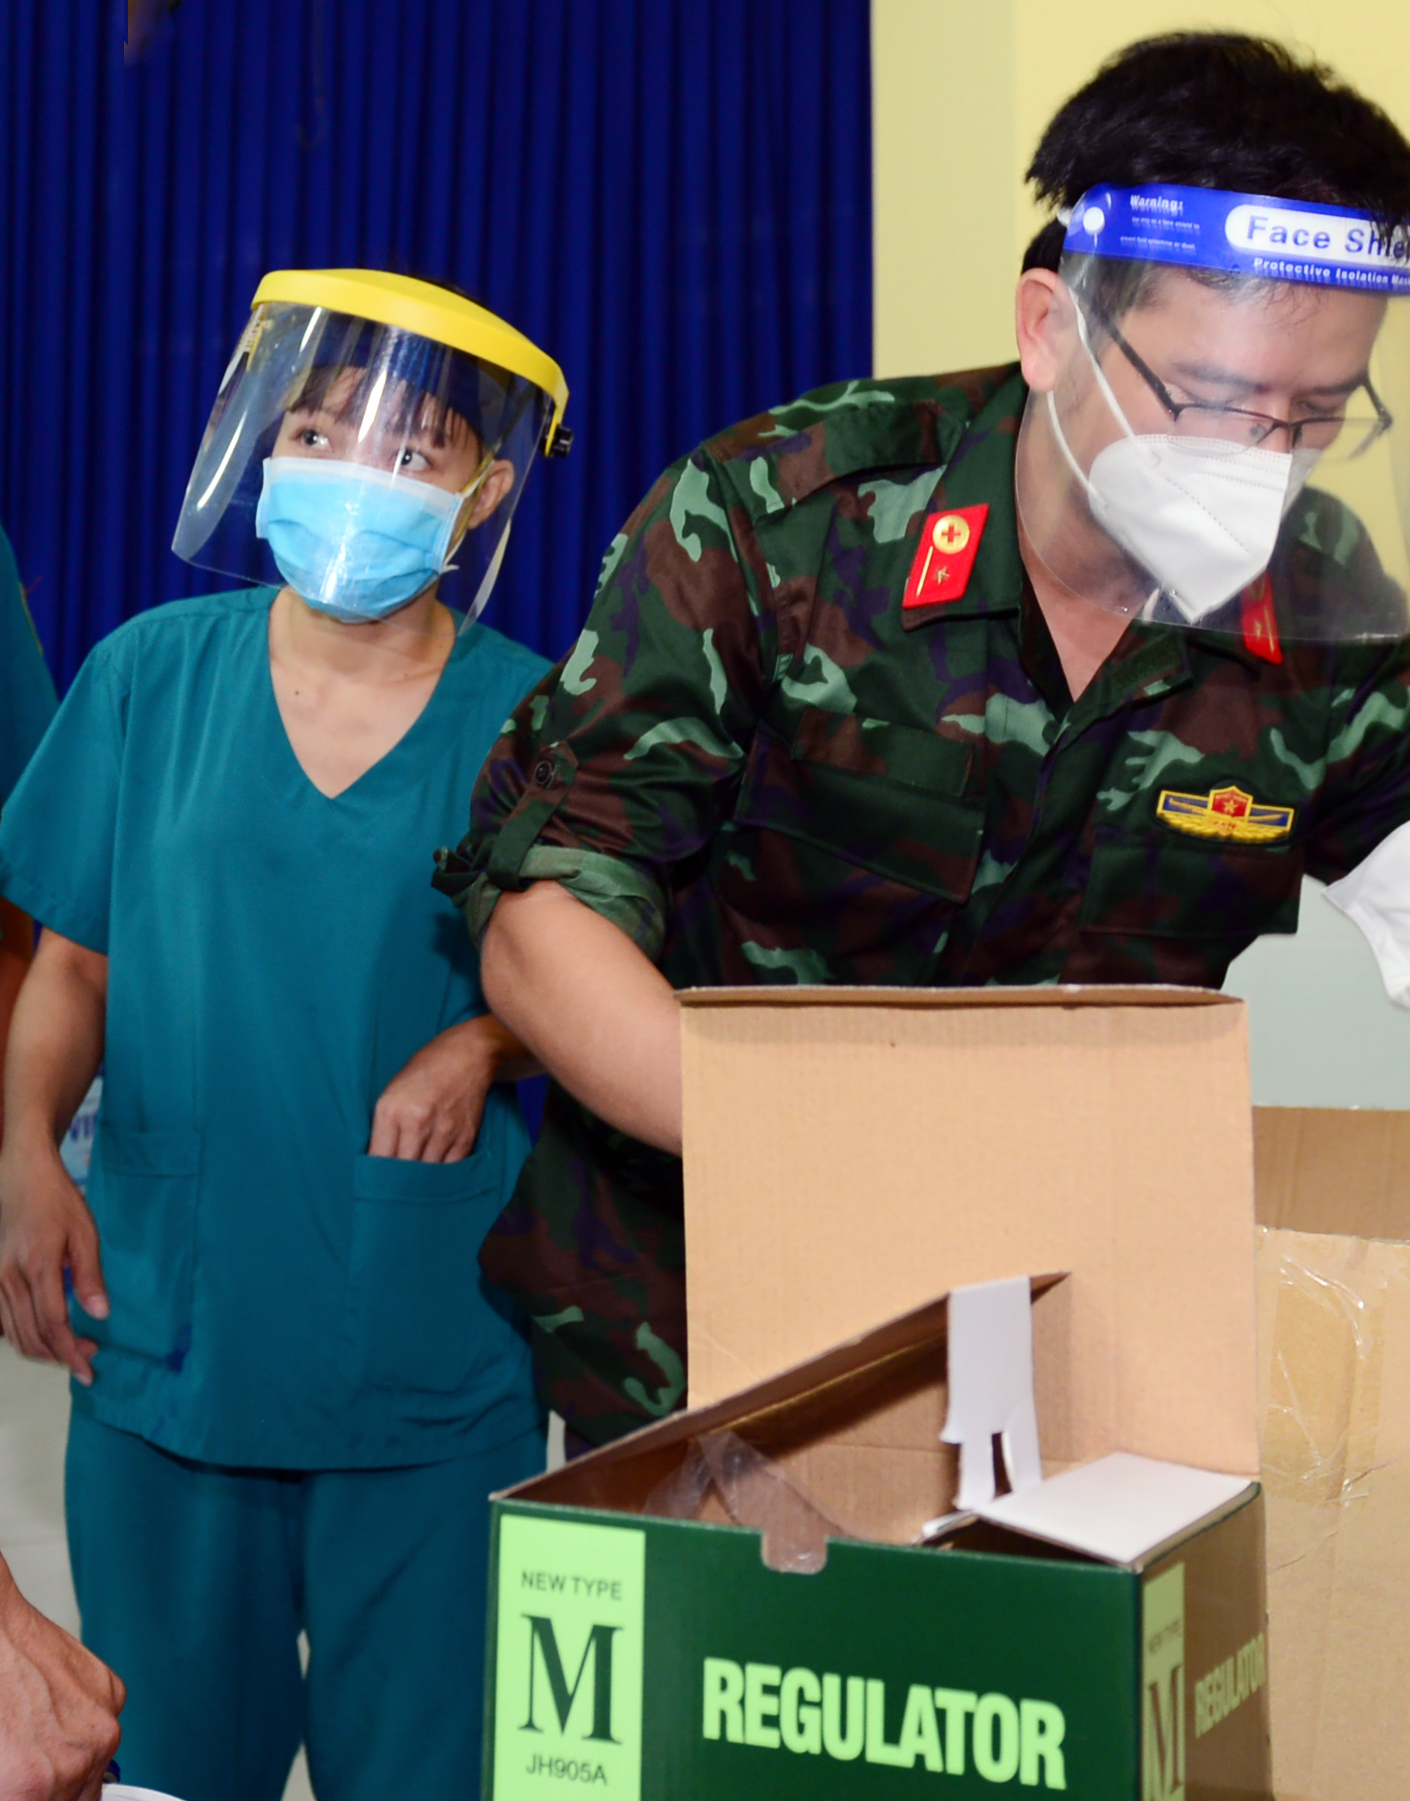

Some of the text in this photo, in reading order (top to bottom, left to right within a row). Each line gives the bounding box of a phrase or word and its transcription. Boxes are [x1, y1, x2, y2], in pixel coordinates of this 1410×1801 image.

[1130, 194, 1183, 212] Warning:
[1246, 215, 1331, 250] Face
[1254, 257, 1331, 277] Protective
[1336, 268, 1389, 284] Isolation
[521, 1570, 623, 1600] NEW TYPE
[517, 1613, 624, 1746] M
[1195, 1632, 1265, 1739] REGULATOR
[703, 1656, 1067, 1790] REGULATOR
[526, 1755, 608, 1786] JH905A
